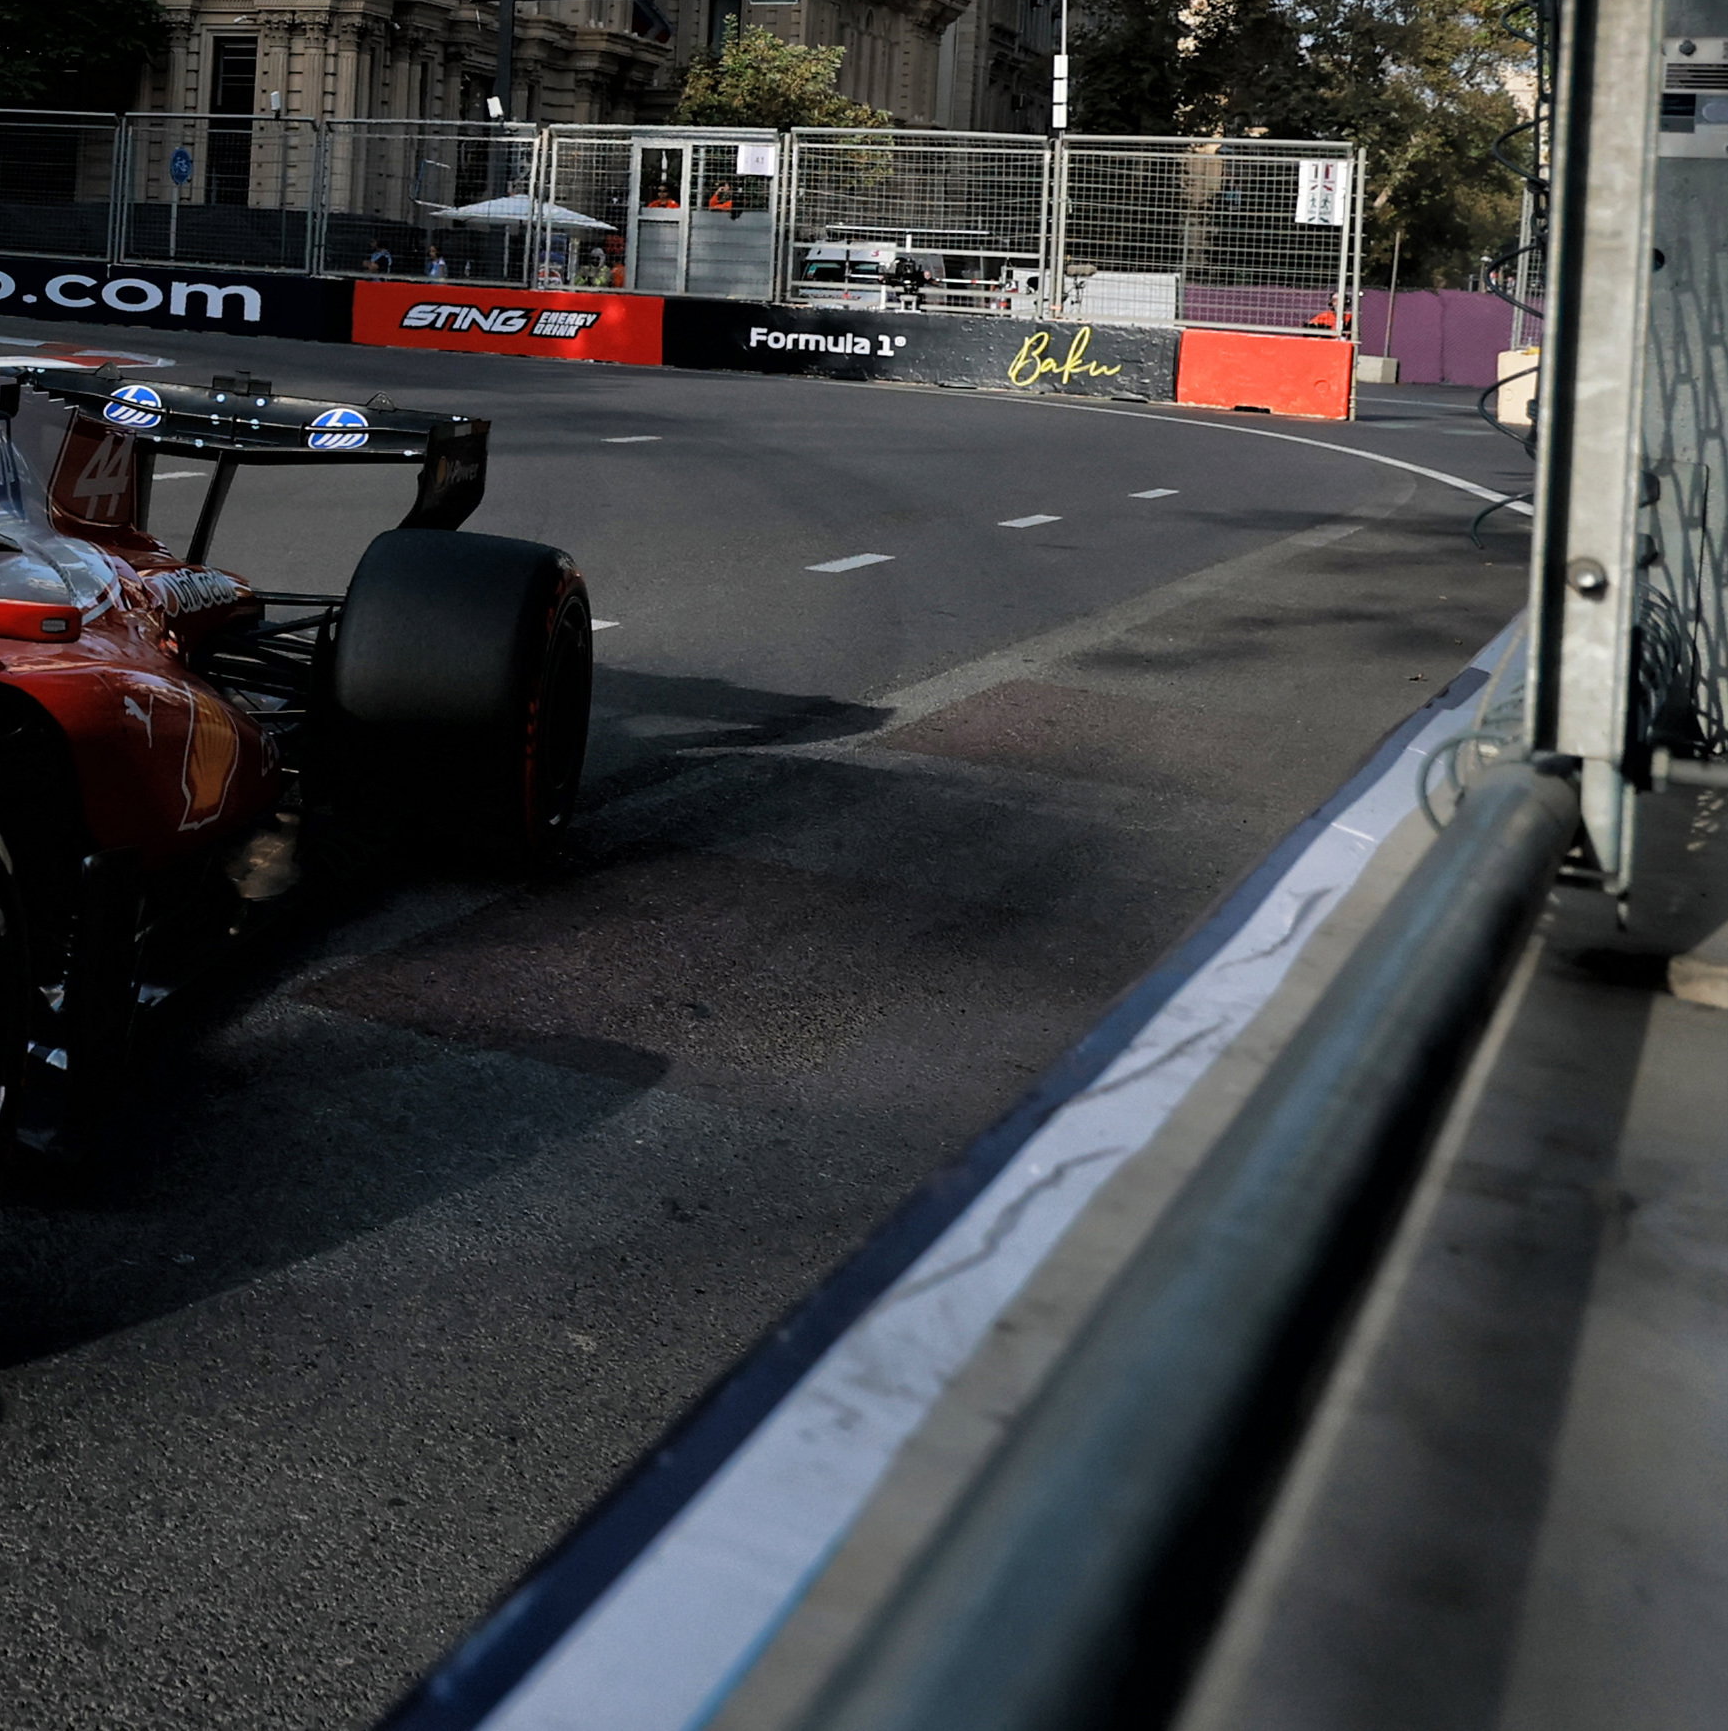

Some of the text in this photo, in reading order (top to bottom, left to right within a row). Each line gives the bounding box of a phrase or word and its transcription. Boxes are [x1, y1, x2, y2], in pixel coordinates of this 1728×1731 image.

[401, 303, 531, 334] STING
[532, 323, 579, 338] DRINK
[539, 311, 599, 328] ENERGY
[749, 326, 871, 356] Formula
[1007, 325, 1124, 387] Baku
[107, 385, 159, 427] hp
[72, 432, 132, 521] 44
